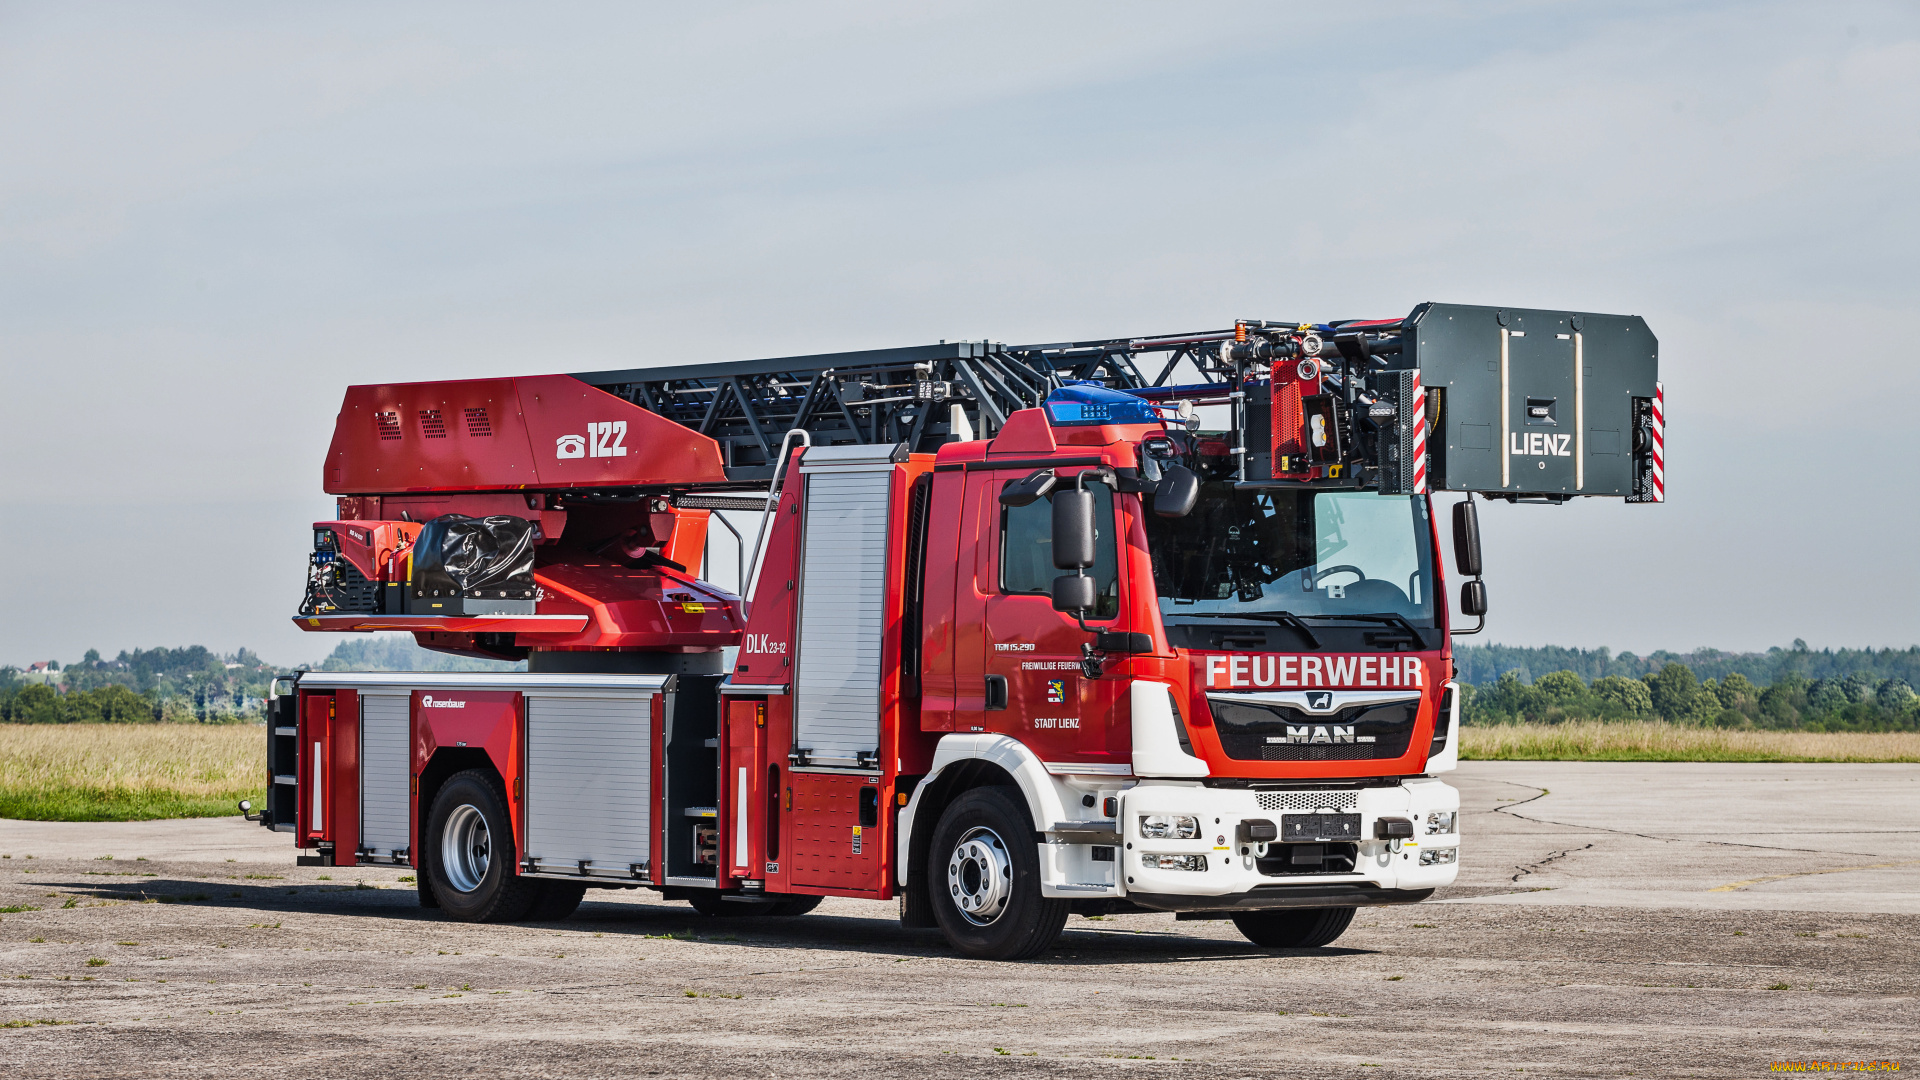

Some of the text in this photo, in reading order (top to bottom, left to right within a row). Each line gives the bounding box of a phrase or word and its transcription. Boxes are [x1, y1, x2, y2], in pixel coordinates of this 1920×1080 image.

[588, 421, 627, 458] 122
[1511, 432, 1571, 456] LIENZ
[746, 633, 786, 654] DLK 23-12
[994, 643, 1035, 651] TGM 15.290
[1022, 661, 1082, 670] FREIWILLIGE FEUERW
[1206, 655, 1423, 686] FEUERWEHR
[432, 698, 466, 708] rosenbauer
[1034, 718, 1080, 729] STADT LIENZ
[1286, 725, 1354, 745] MAN
